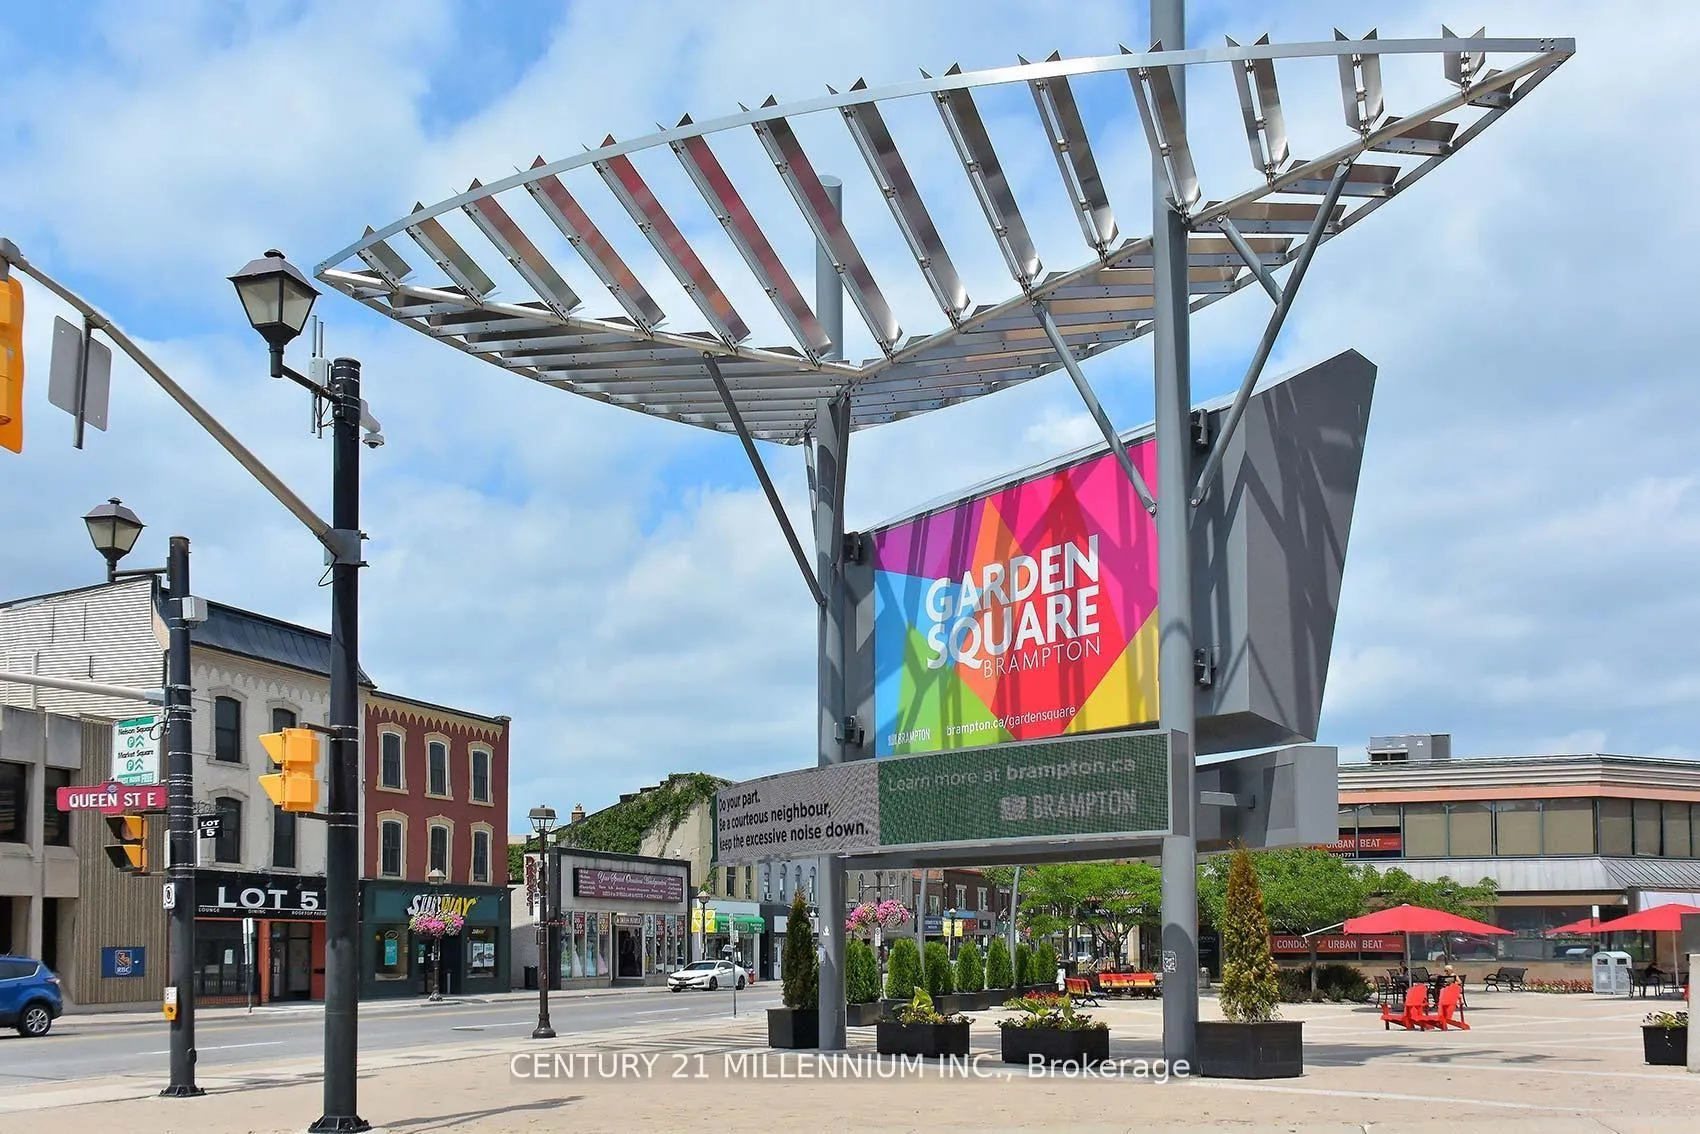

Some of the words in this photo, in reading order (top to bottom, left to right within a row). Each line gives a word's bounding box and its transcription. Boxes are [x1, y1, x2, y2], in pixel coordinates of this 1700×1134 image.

[925, 534, 1100, 622] GARDEN
[927, 583, 1100, 669] SQUARE
[983, 635, 1100, 678] BRAMPTON
[946, 706, 1075, 736] brampton.ca/gardensquare
[888, 776, 930, 792] Learn
[934, 770, 978, 786] more
[983, 768, 1000, 782] at
[1006, 758, 1136, 781] brampton.ca
[69, 794, 117, 807] QUEEN
[124, 793, 140, 806] ST
[147, 793, 156, 806] E
[719, 799, 726, 811] Do
[727, 796, 741, 812] your
[742, 790, 760, 808] part.
[1033, 790, 1136, 819] BRAMPTON
[727, 820, 730, 829] a
[732, 810, 768, 829] courteous
[771, 802, 832, 822] neighbour,
[733, 834, 744, 848] the
[746, 828, 787, 846] excessive
[790, 824, 822, 841] noise
[826, 822, 869, 838] down.
[1360, 838, 1381, 848] BEAT
[218, 887, 288, 909] LOT
[300, 891, 318, 910] 5
[407, 894, 476, 918] SUBWAY
[1328, 940, 1356, 949] URBAN
[1362, 940, 1383, 949] BEAT
